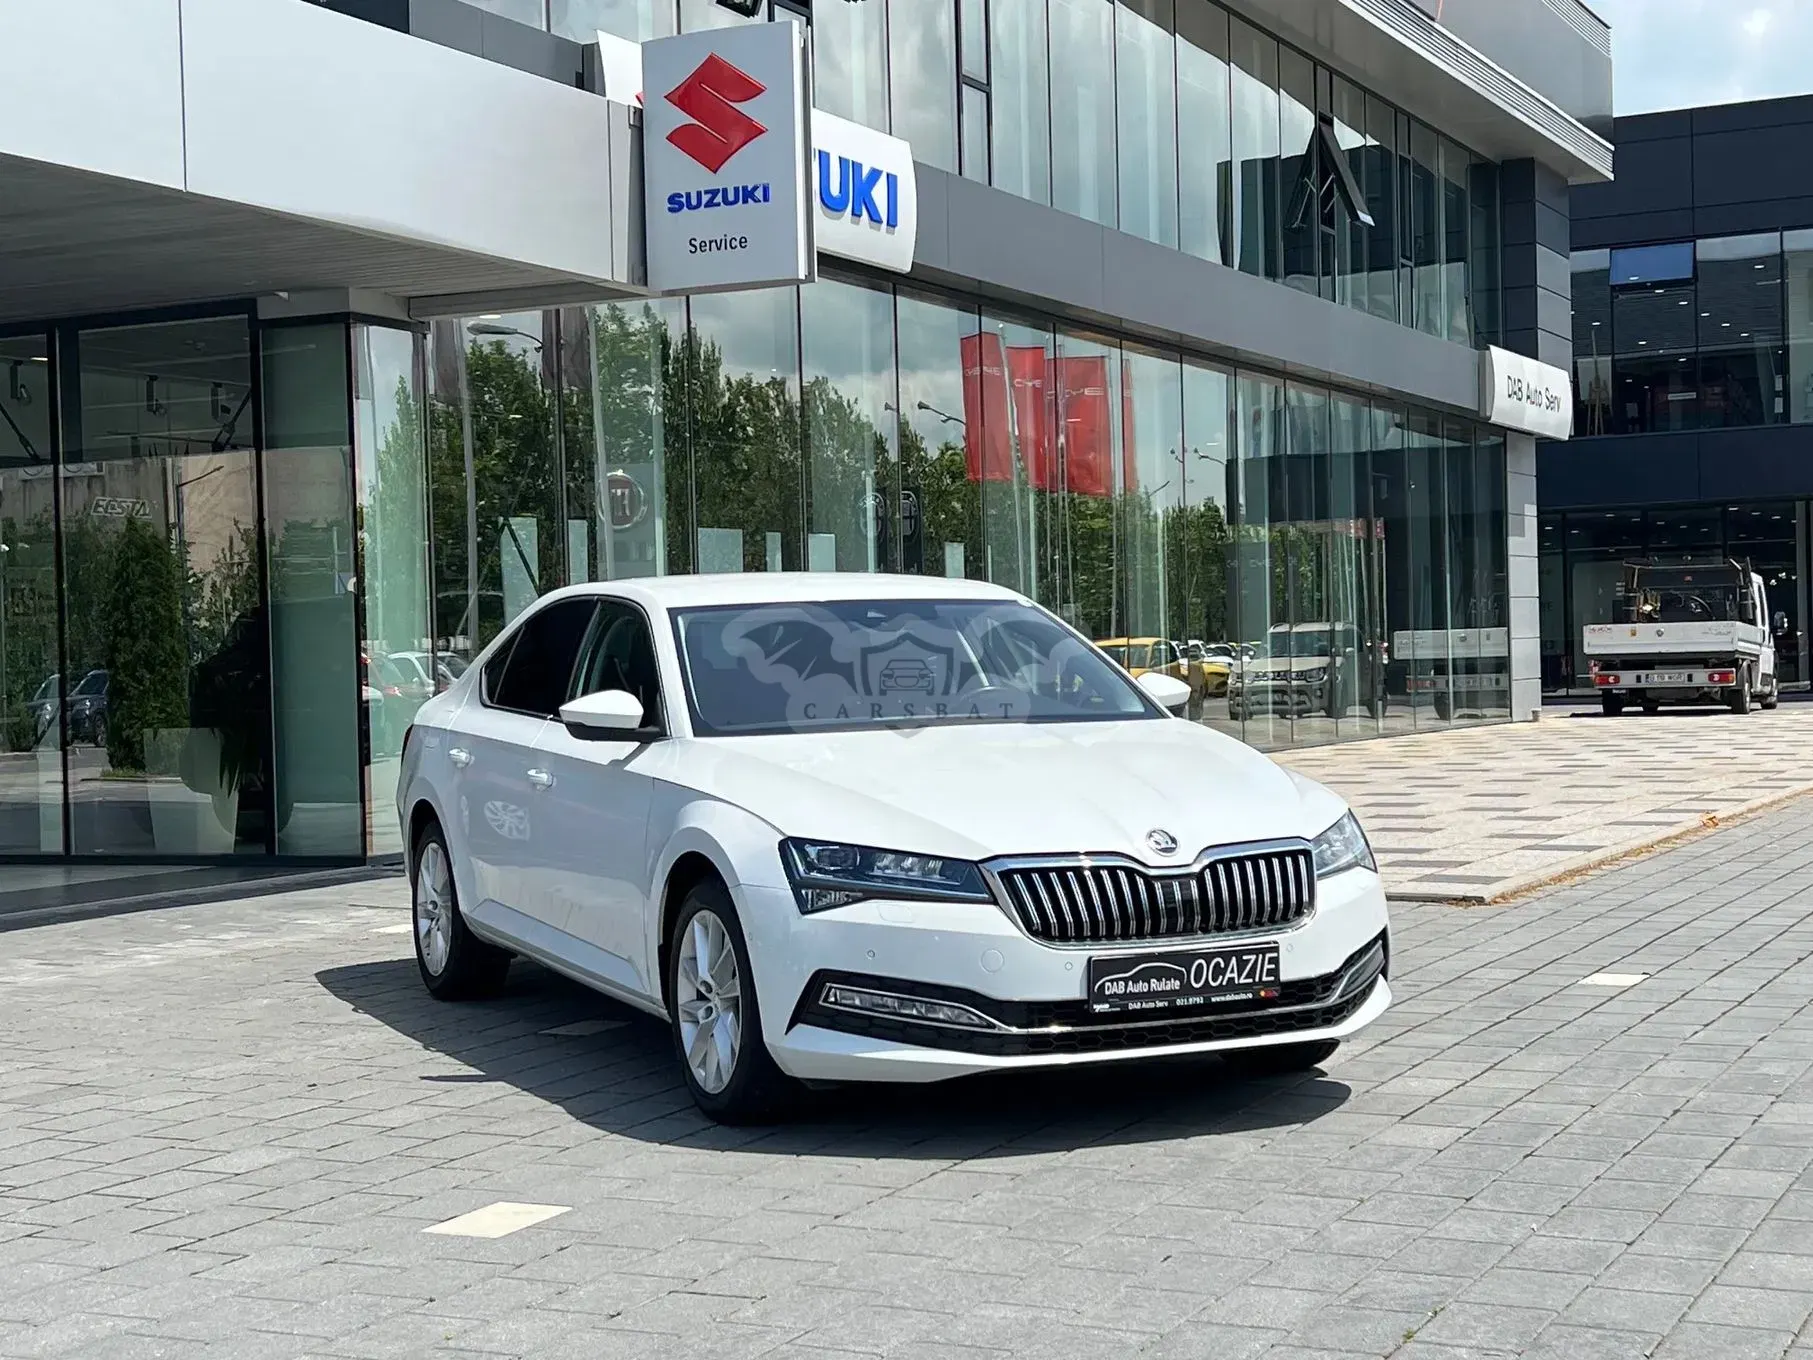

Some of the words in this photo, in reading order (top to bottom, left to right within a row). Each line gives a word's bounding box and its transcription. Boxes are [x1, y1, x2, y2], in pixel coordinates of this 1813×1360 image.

[667, 182, 770, 213] SUZUKI
[814, 149, 899, 230] UKI
[688, 234, 749, 255] Service
[1507, 375, 1523, 402] DAB
[1526, 382, 1543, 407] Auto
[1545, 387, 1561, 412] Serv
[1190, 952, 1278, 988] OCAZIE
[1104, 980, 1125, 996] DAB
[1127, 978, 1149, 993] Auto
[1150, 977, 1180, 992] Rulate
[1128, 1001, 1141, 1010] DAB
[1142, 1000, 1155, 1009] Auto
[1156, 999, 1168, 1008] Serv
